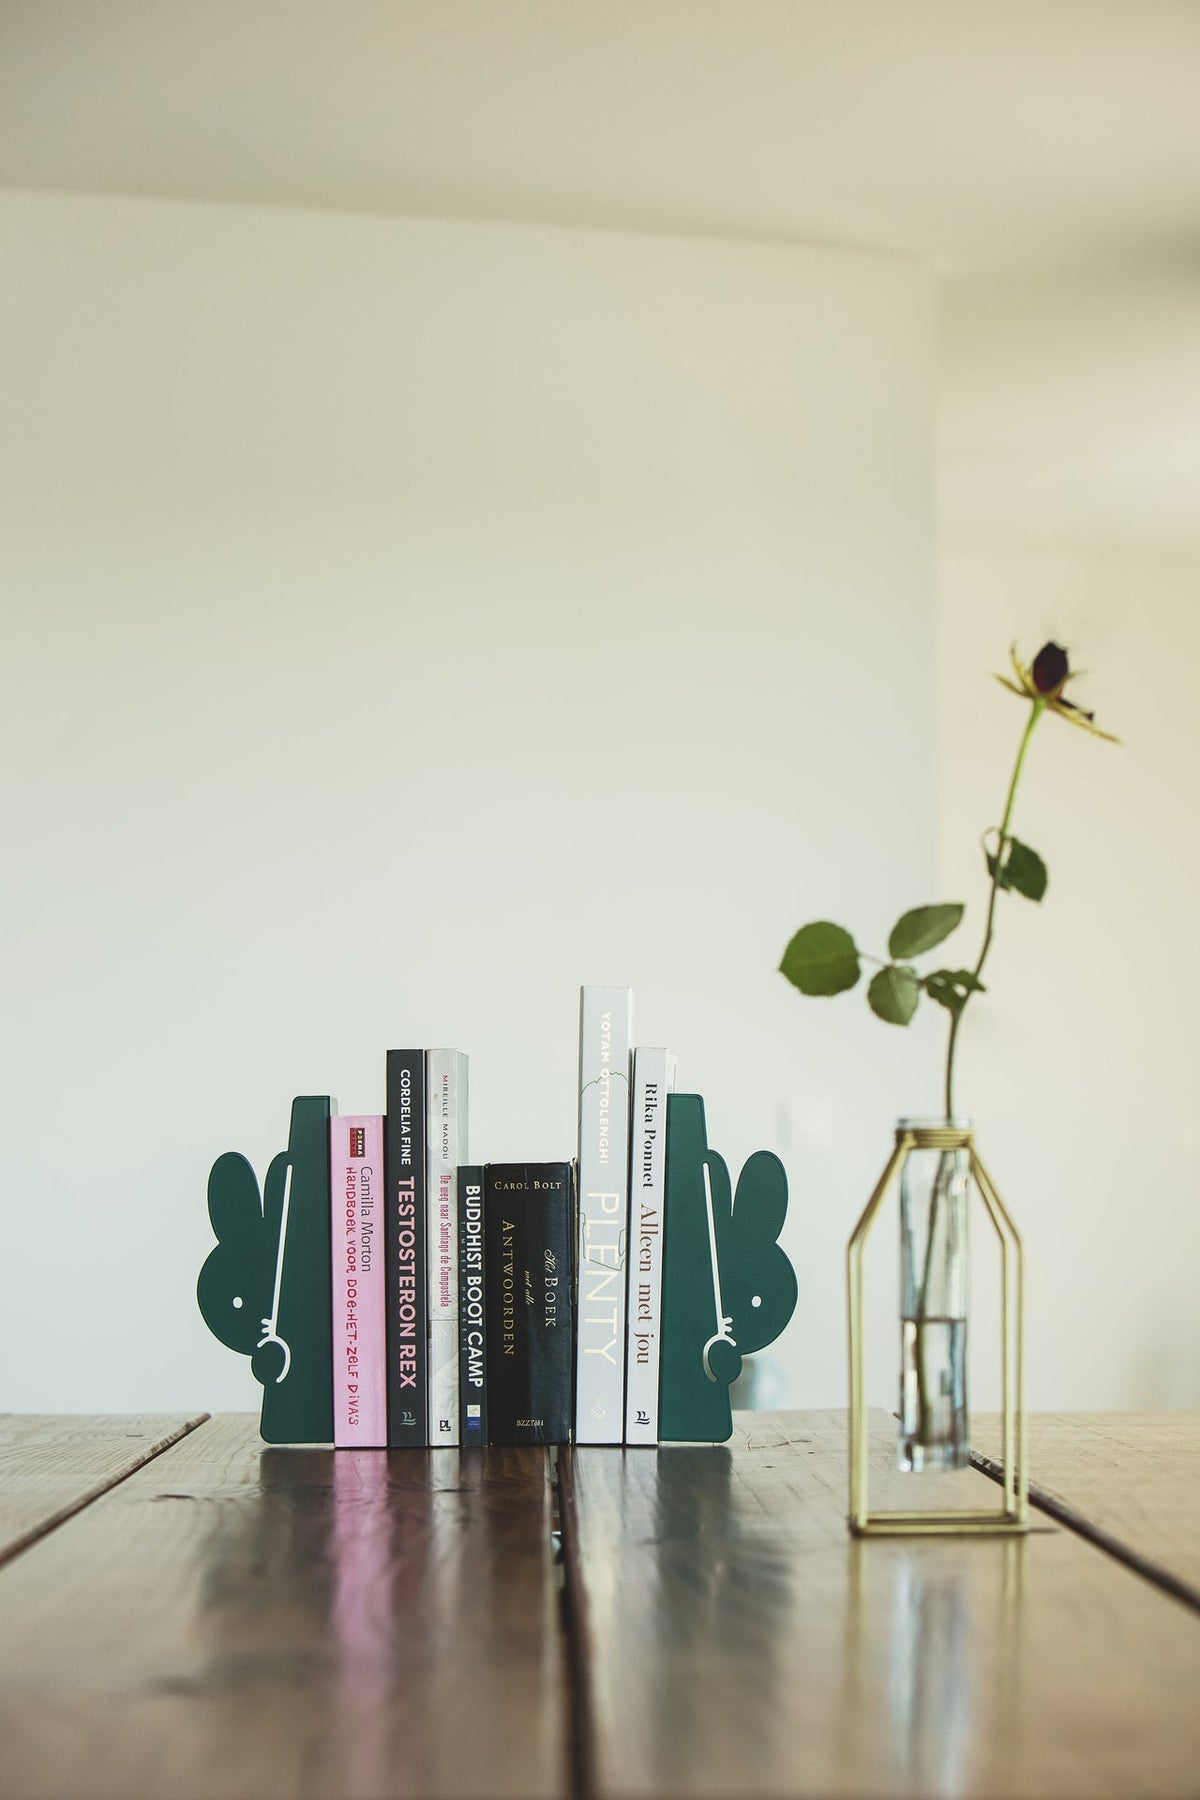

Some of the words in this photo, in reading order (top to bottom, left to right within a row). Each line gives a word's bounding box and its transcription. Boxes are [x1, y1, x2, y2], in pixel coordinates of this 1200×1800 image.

[600, 1012, 611, 1063] YOTAM
[400, 1069, 411, 1134] CORDELIA
[599, 1068, 610, 1164] OTTOLENGHI
[644, 1083, 658, 1123] Rika
[401, 1135, 412, 1166] FINE
[642, 1129, 657, 1188] Ponnet
[361, 1166, 374, 1217] Camilla
[438, 1186, 449, 1202] weg
[440, 1175, 451, 1184] De
[494, 1181, 529, 1190] CAROL
[534, 1180, 562, 1190] BOLT
[439, 1204, 449, 1220] naar
[465, 1185, 482, 1270] BUDDHIST
[361, 1221, 374, 1272] Morton
[398, 1176, 416, 1337] TESTOSTERON
[438, 1222, 452, 1253] Santiago
[440, 1255, 452, 1264] de
[639, 1204, 659, 1273] Alleen
[439, 1266, 452, 1308] Compostela
[467, 1277, 483, 1326] BOOT
[502, 1219, 516, 1356] ANTWOORDEN
[524, 1270, 532, 1288] met
[524, 1288, 535, 1305] alle
[544, 1277, 559, 1327] BOEK
[583, 1192, 620, 1365] PLENTY
[637, 1283, 653, 1322] met
[400, 1344, 417, 1389] REX
[468, 1331, 484, 1388] CAMP
[634, 1333, 654, 1364] jou
